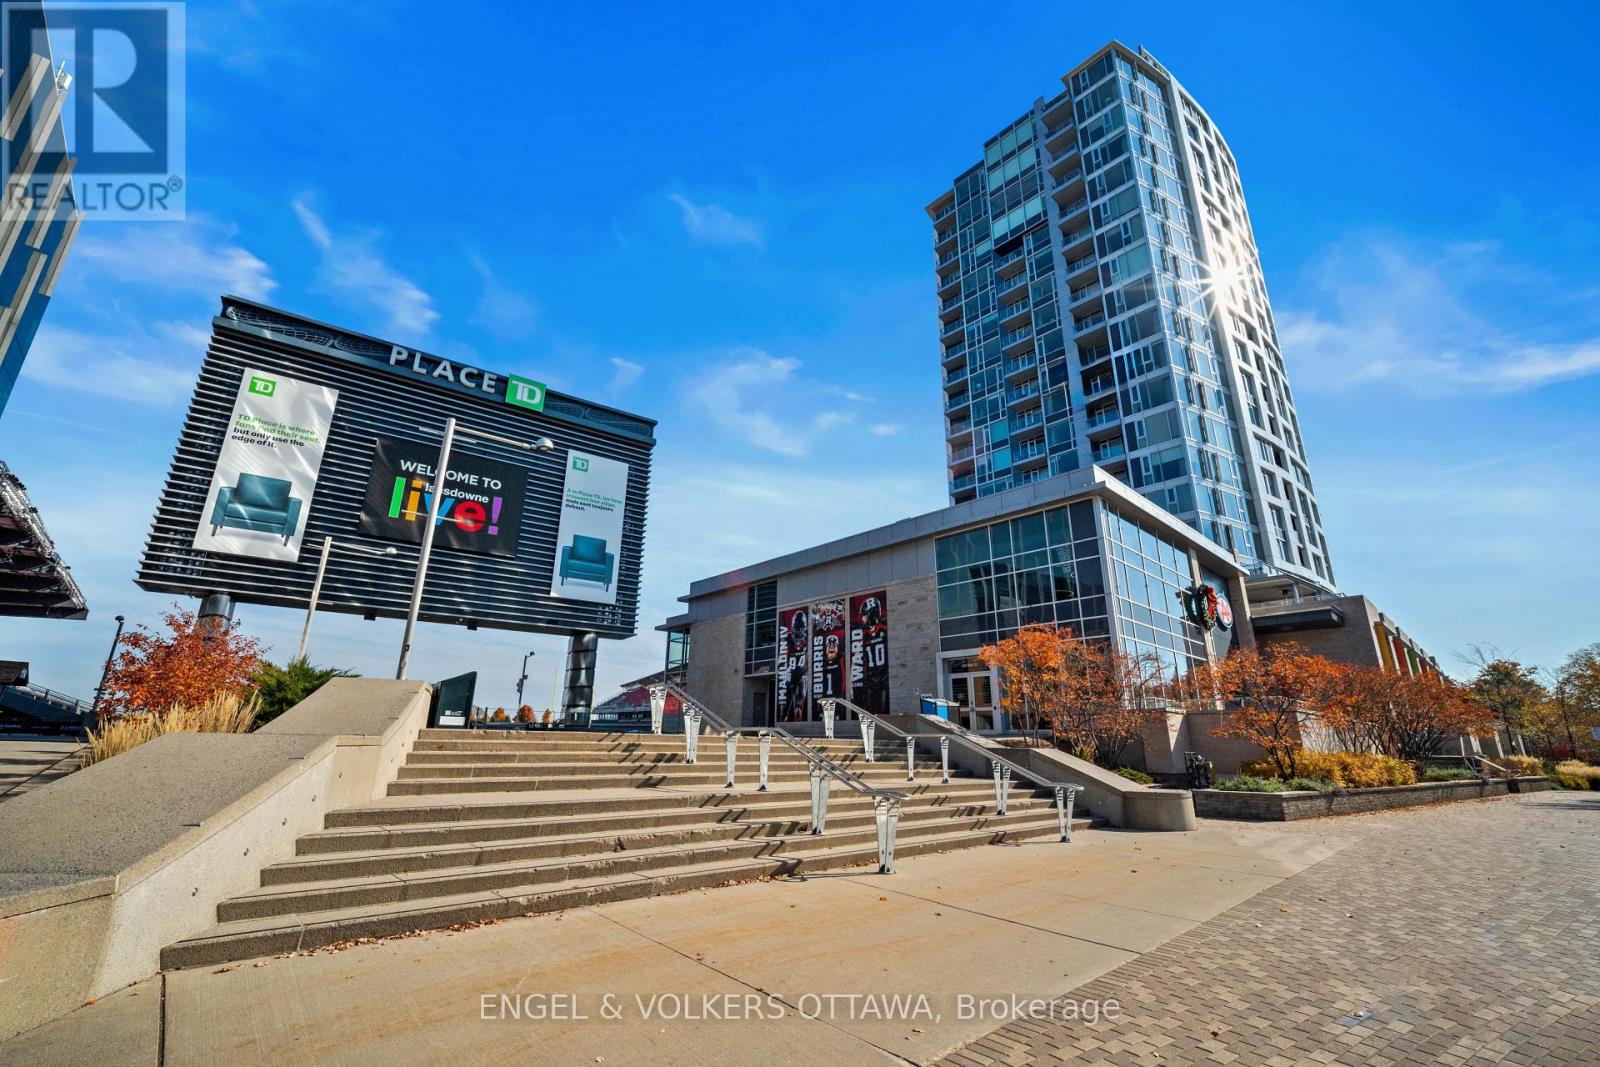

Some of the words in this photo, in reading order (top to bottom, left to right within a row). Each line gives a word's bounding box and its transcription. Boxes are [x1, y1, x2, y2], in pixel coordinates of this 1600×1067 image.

[252, 379, 273, 393] TD
[389, 345, 498, 394] PLACE
[512, 380, 541, 405] TD
[231, 434, 255, 445] edge
[256, 438, 267, 446] of
[233, 427, 249, 436] but
[250, 429, 271, 440] only
[272, 435, 289, 444] use
[289, 437, 304, 447] the
[400, 459, 479, 486] WELOME
[482, 476, 502, 490] TO
[388, 476, 503, 535] live!
[424, 482, 489, 504] lasdowne
[813, 636, 824, 694] BURRIS
[852, 629, 864, 682] WARD
[866, 643, 885, 668] 10
